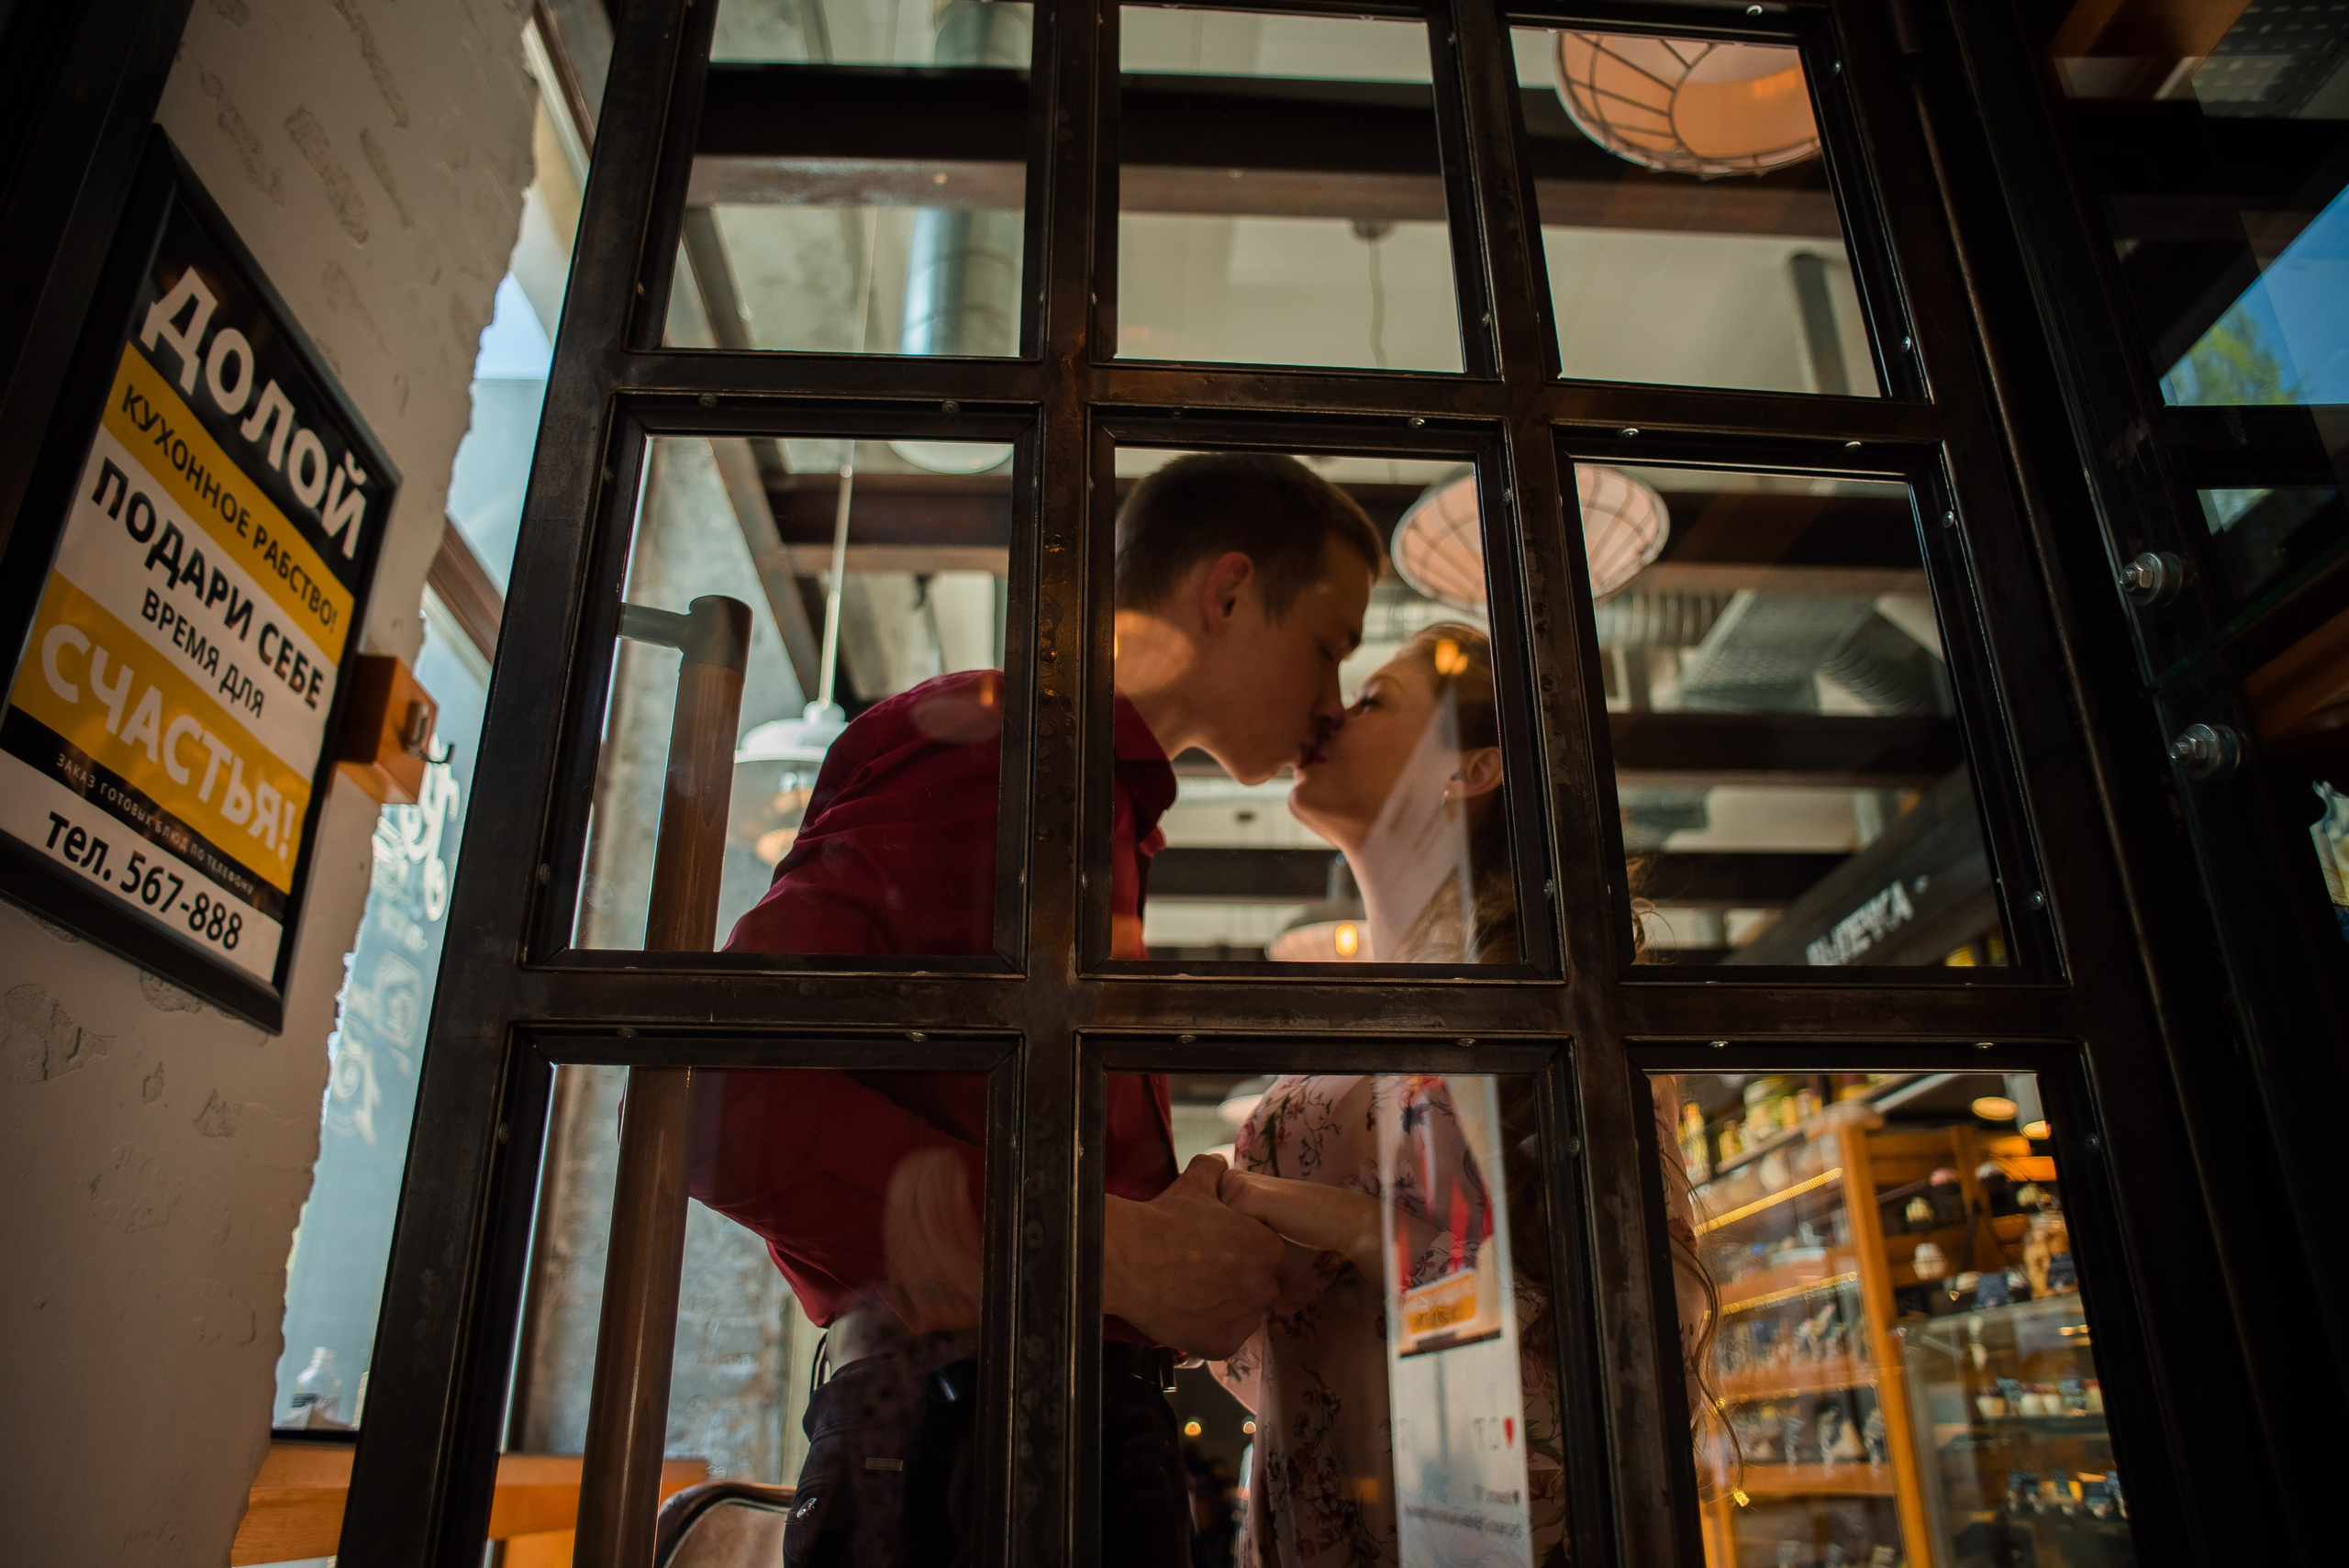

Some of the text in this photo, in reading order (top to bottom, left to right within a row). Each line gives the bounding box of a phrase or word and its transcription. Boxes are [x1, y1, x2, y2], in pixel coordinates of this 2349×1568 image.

[122, 384, 338, 633] КУХОННОЕ РАБСТВО!
[139, 266, 367, 560] ДОЛОЙ
[92, 456, 324, 709] ПОДАРИ СЕБЕ
[141, 587, 264, 718] ВРЕМЯ ДЛЯ
[41, 624, 296, 859] СЧАСТЬЯ!
[56, 753, 95, 789] ЗАКАЗ
[99, 782, 152, 828] ГОТОВЫХ
[155, 819, 188, 853] БЛЮД
[46, 811, 243, 951] тел. 567-888
